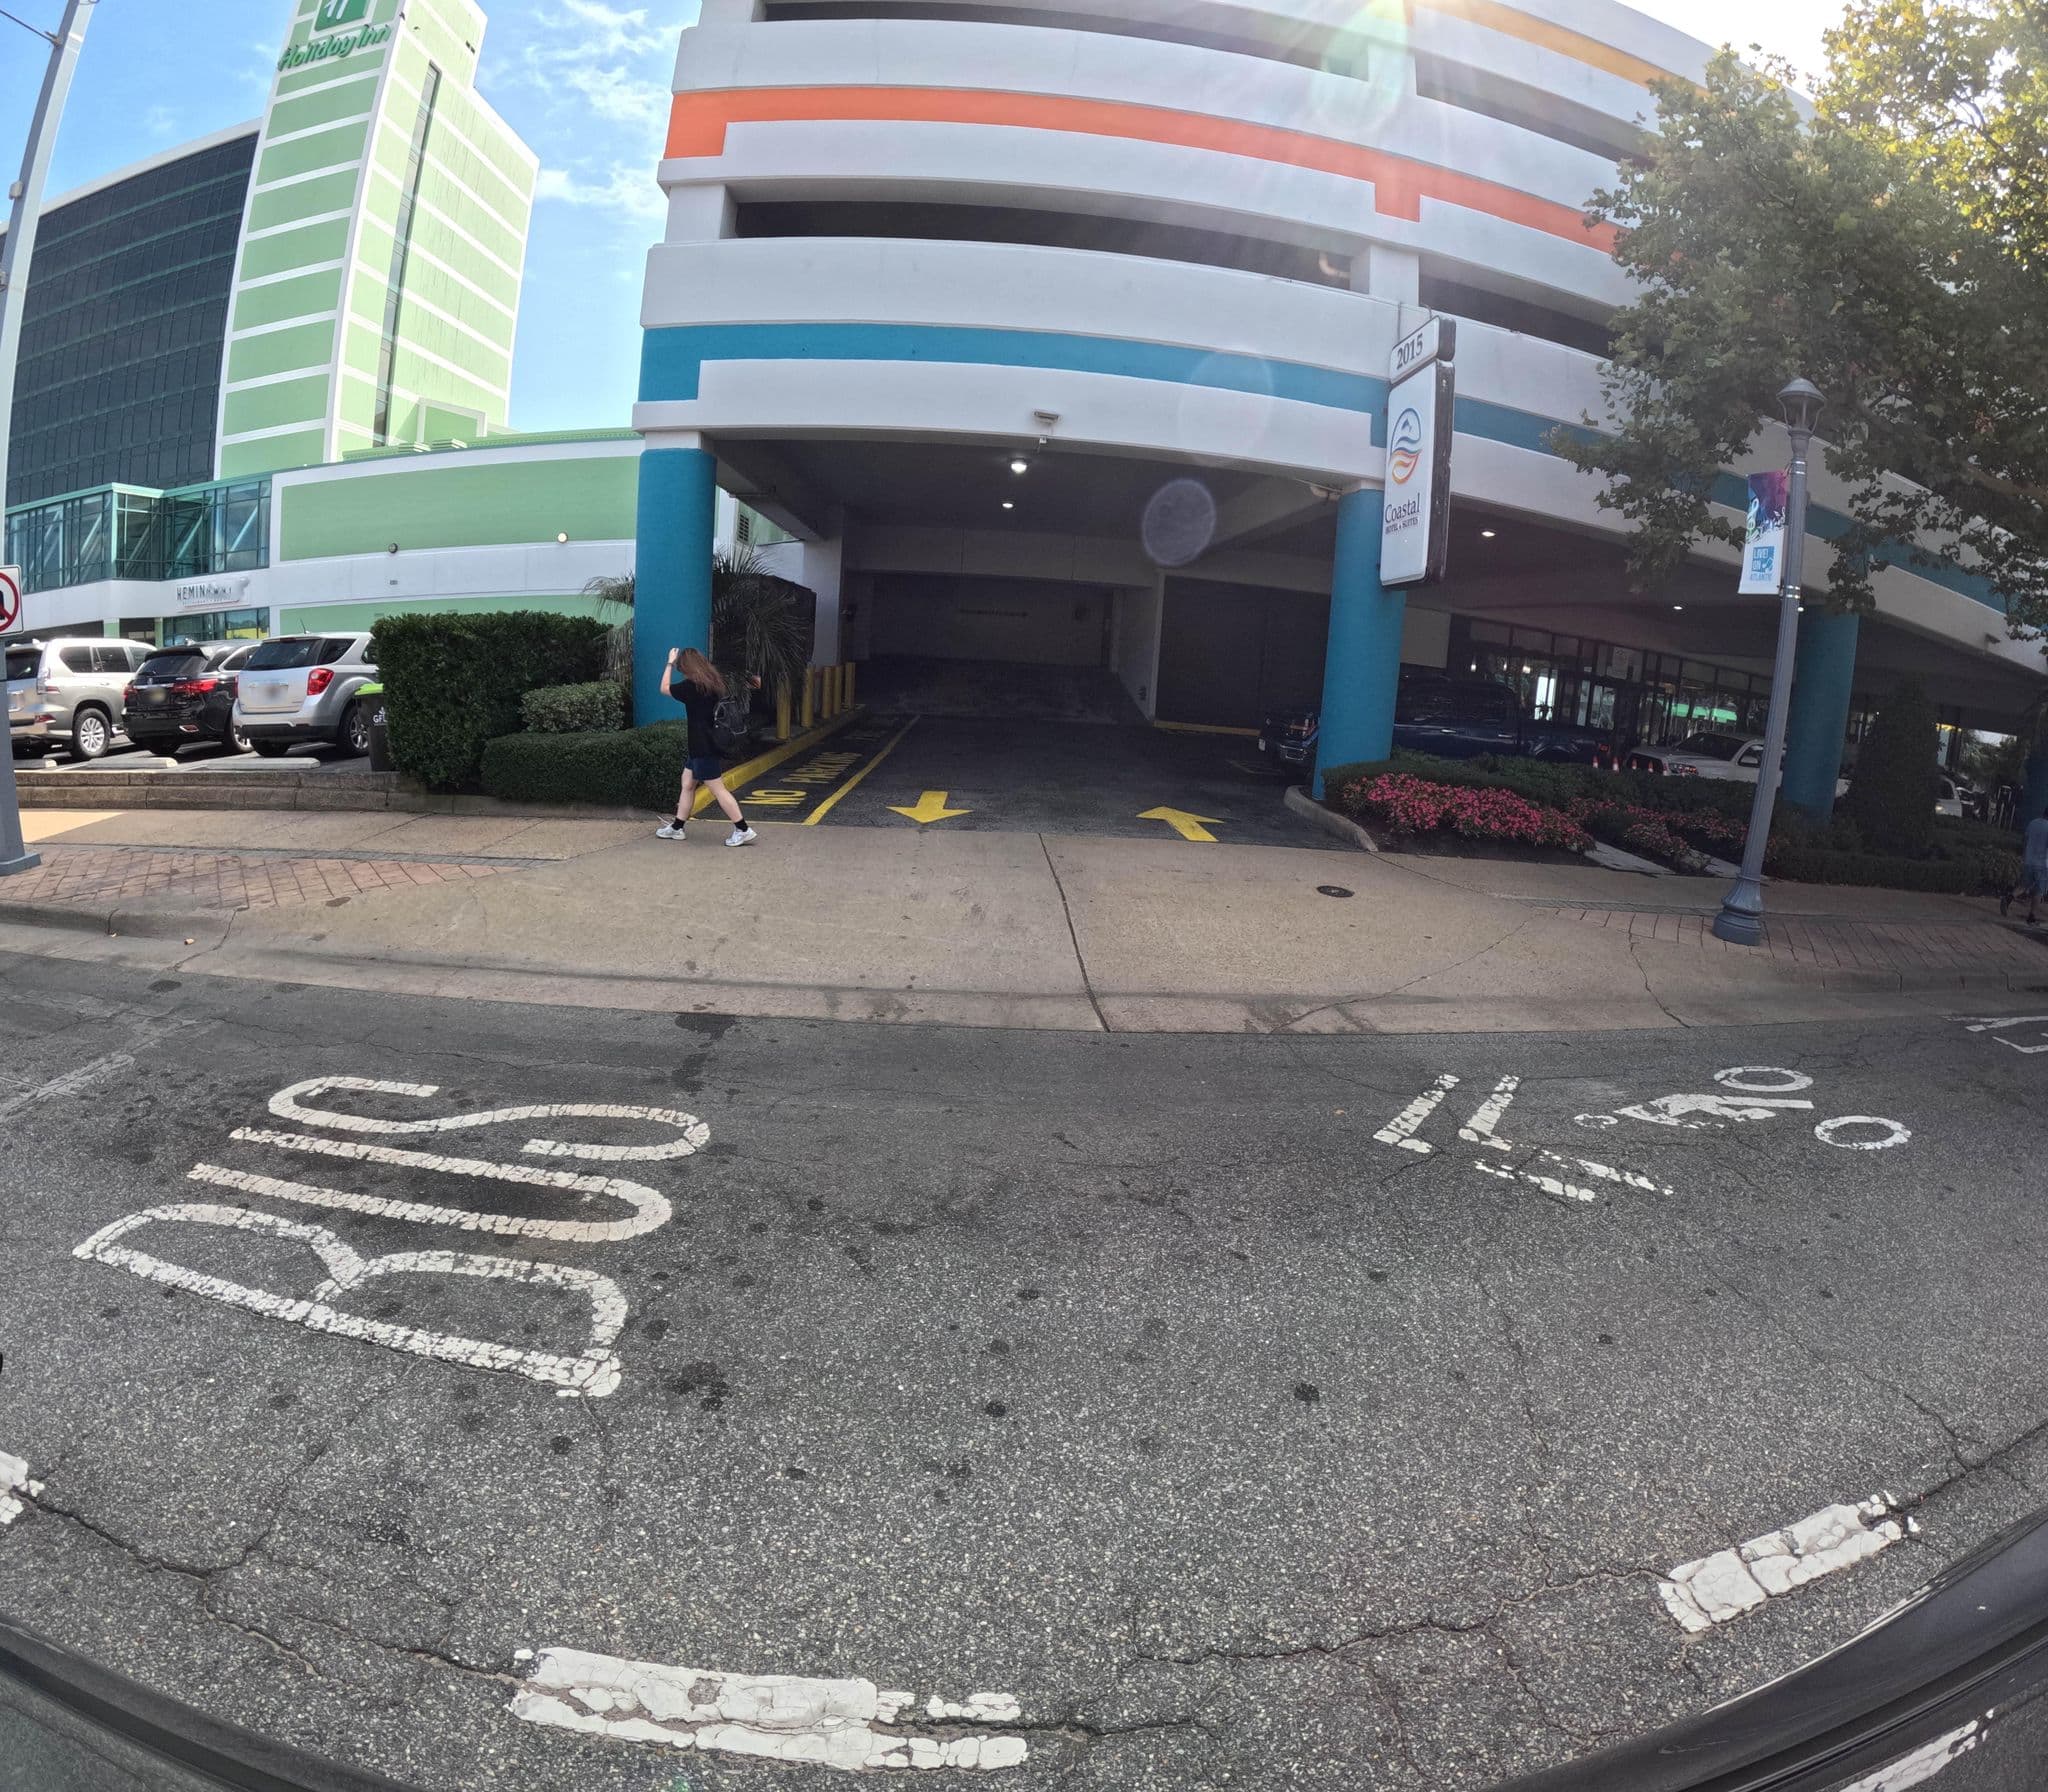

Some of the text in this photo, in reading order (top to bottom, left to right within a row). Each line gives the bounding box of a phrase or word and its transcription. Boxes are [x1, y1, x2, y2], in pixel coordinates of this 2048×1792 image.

[278, 24, 391, 72] Holiday Inn
[1396, 332, 1423, 370] 2015
[1385, 492, 1420, 523] Coastal
[739, 789, 807, 805] NO
[72, 1075, 711, 1398] BUS
